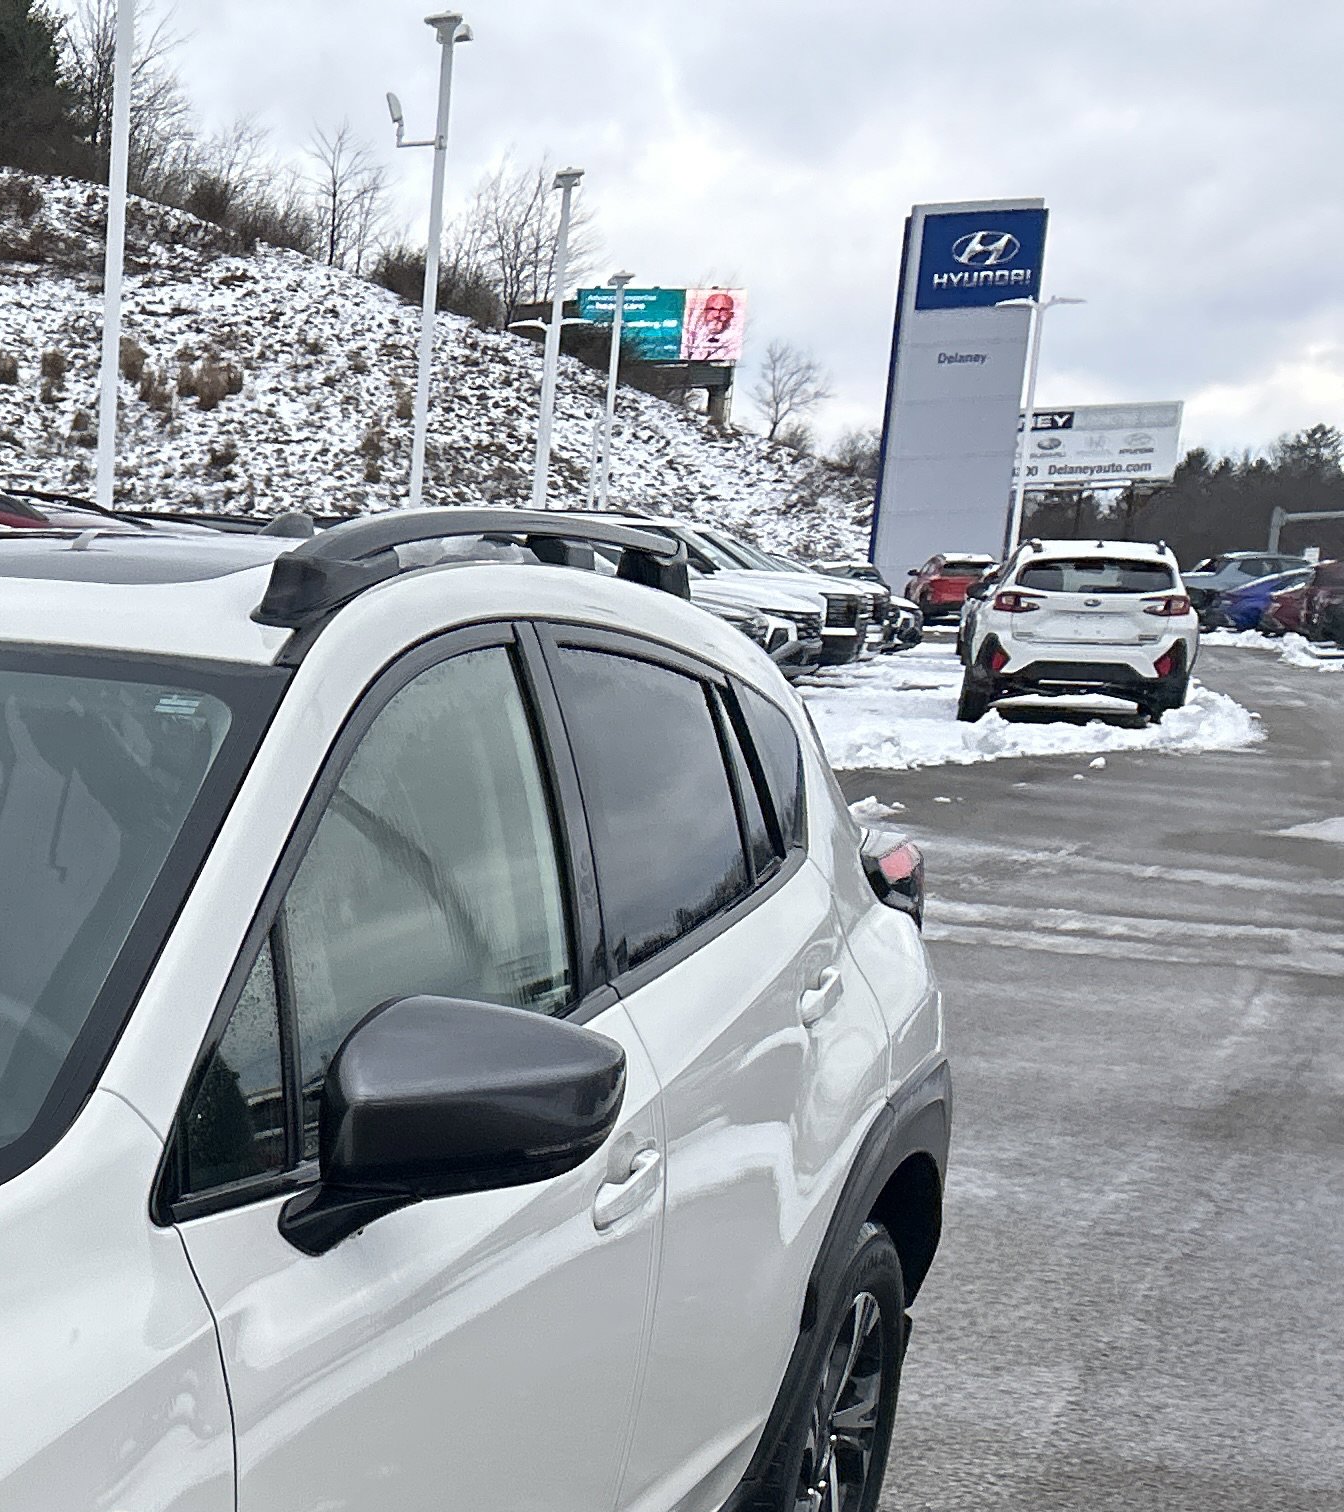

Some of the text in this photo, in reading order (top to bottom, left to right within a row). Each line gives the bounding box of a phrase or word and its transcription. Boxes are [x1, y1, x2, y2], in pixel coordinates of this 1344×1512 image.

[932, 268, 1032, 290] HYUNDAI
[937, 352, 989, 366] Delaney
[1047, 462, 1153, 476] Delaneyauto.com
